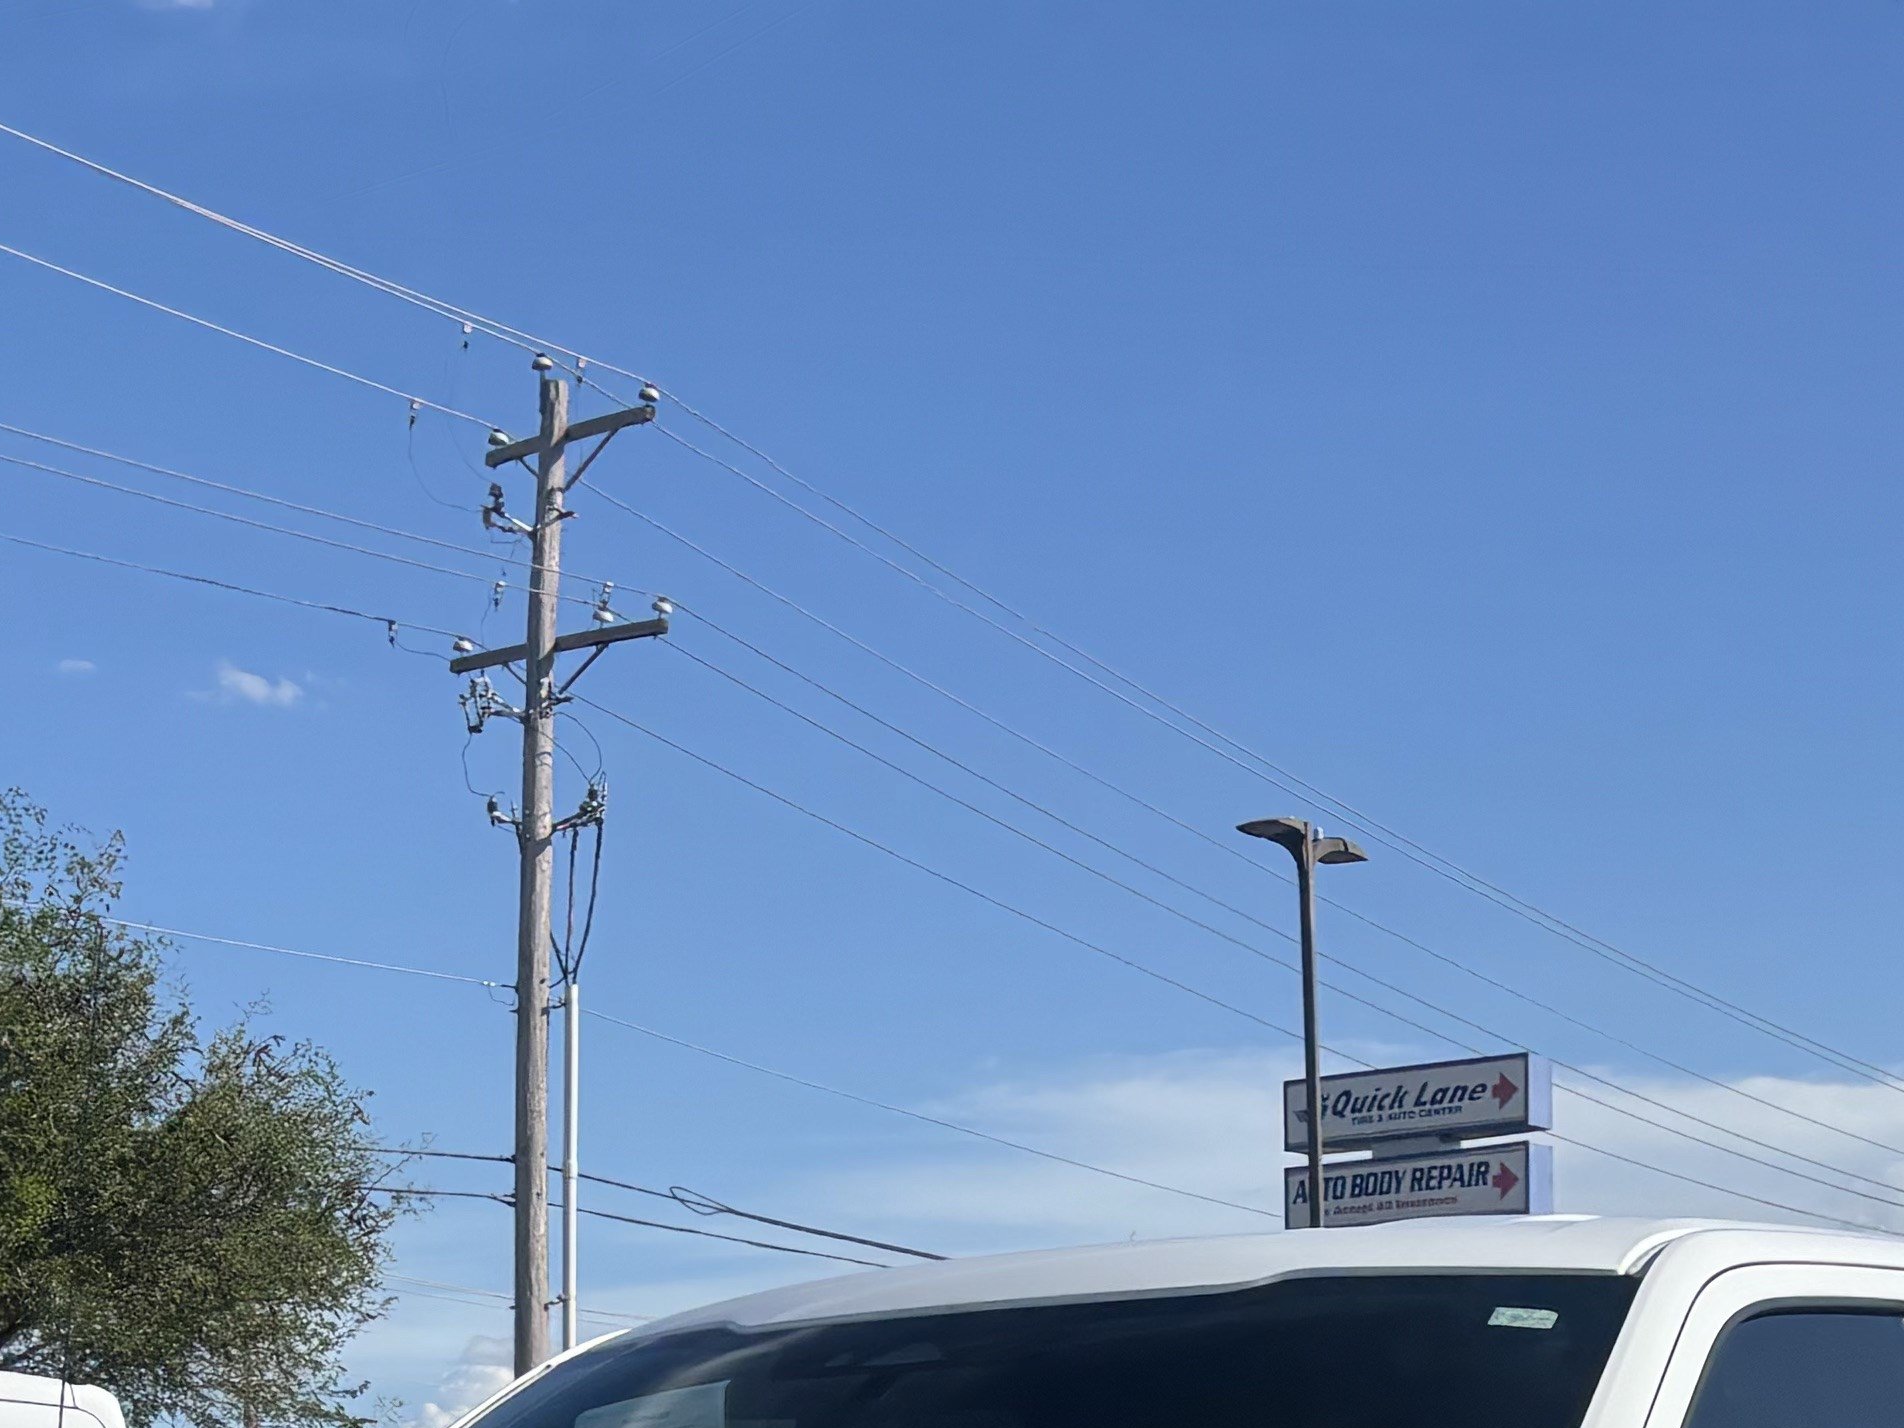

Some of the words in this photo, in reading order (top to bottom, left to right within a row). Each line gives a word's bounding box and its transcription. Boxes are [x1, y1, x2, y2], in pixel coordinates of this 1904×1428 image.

[1332, 1083, 1406, 1117] Quick
[1413, 1082, 1487, 1108] Lane
[1293, 1176, 1345, 1204] ATO
[1350, 1169, 1406, 1198] BODY
[1410, 1161, 1490, 1192] REPAIR
